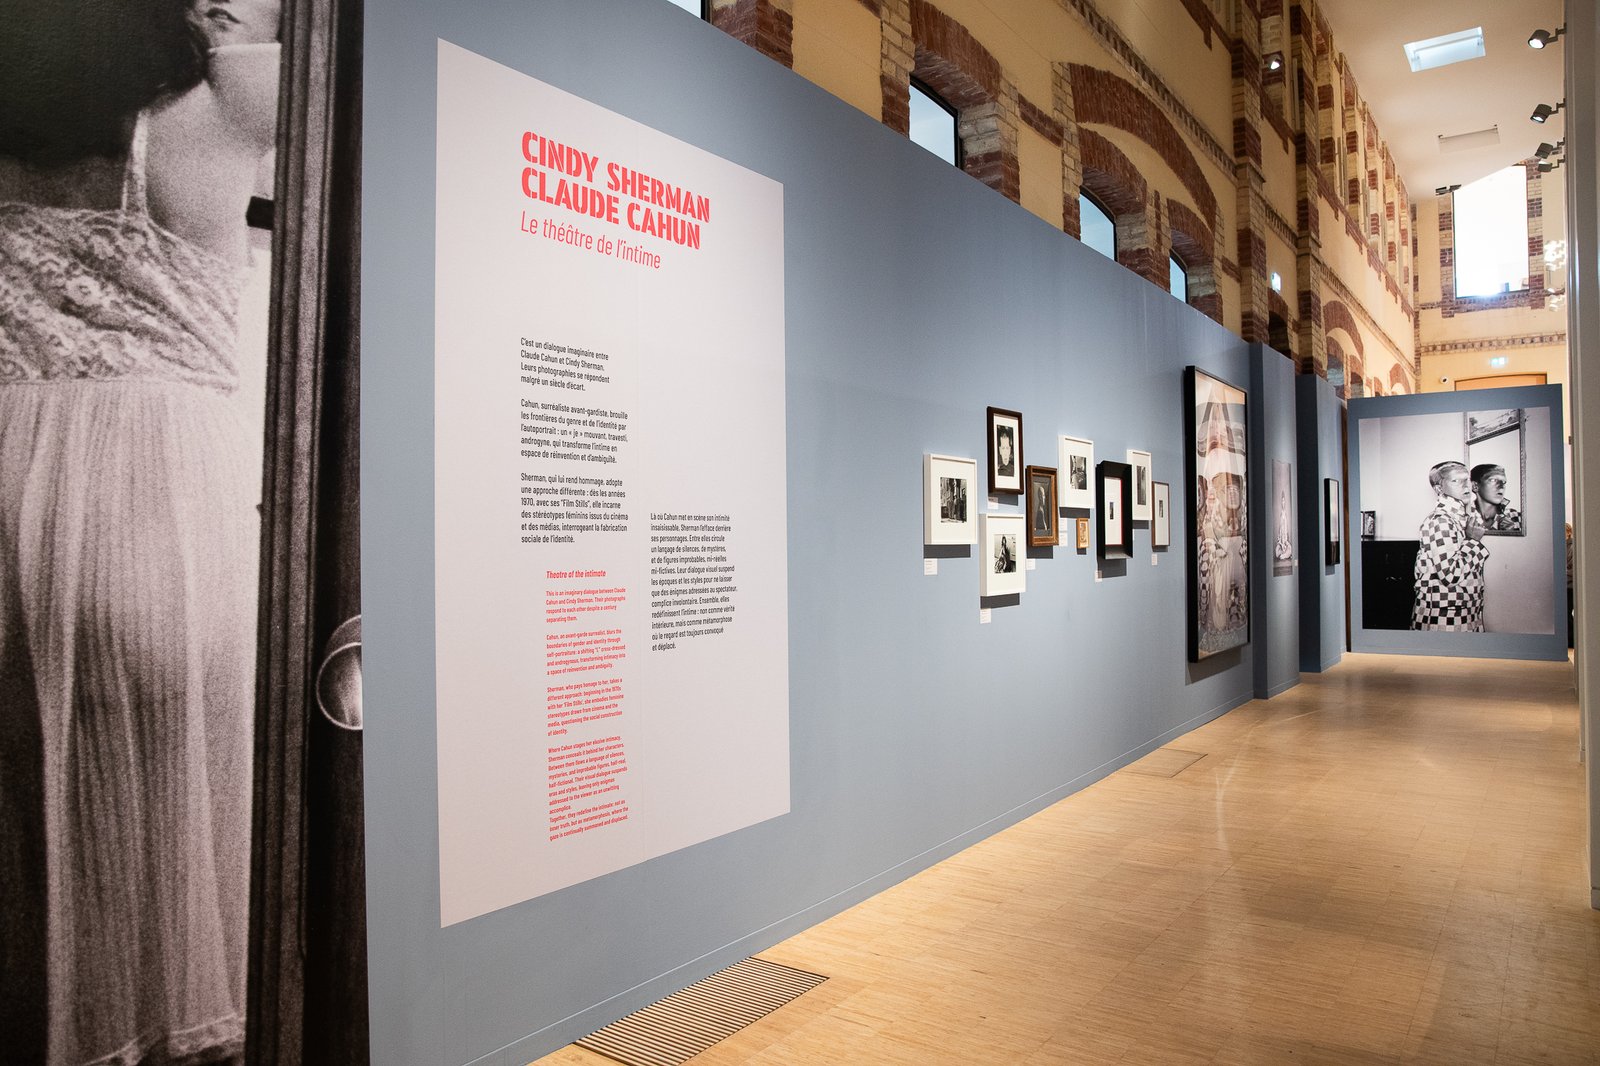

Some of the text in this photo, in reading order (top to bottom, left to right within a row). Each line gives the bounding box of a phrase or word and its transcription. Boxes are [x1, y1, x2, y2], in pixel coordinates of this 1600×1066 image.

[522, 132, 710, 223] CINDY SHERMAN
[522, 167, 700, 250] CLAUDE CAHUN
[521, 211, 660, 269] Le théâtre de l'intime
[521, 337, 534, 347] C'est
[543, 342, 566, 354] dialogue
[567, 345, 595, 358] imaginaire
[595, 353, 609, 361] entre
[521, 349, 540, 361] Claude
[541, 353, 558, 363] Cahun
[559, 357, 565, 365] et
[565, 357, 580, 369] Cindy
[521, 362, 537, 372] Leurs
[538, 365, 576, 379] photographies
[584, 373, 610, 383] répondent
[521, 375, 541, 386] malgré
[549, 378, 565, 389] siècle
[541, 403, 570, 413] surréaliste
[610, 410, 628, 420] brouille
[521, 411, 529, 420] les
[530, 412, 557, 423] frontières
[558, 416, 566, 424] du
[566, 418, 581, 426] genre
[588, 419, 595, 427] de
[573, 429, 579, 439] je
[552, 439, 561, 449] qui
[562, 440, 591, 450] transforme
[521, 450, 541, 459] espace
[542, 450, 549, 459] de
[550, 450, 580, 461] réinvention
[548, 474, 557, 485] qui
[565, 476, 578, 484] rend
[606, 478, 623, 488] adopte
[533, 487, 559, 495] approche
[559, 487, 586, 496] différente
[589, 489, 599, 497] dès
[599, 489, 607, 497] les
[608, 490, 626, 498] années
[592, 500, 601, 509] elle
[602, 500, 621, 509] incarne
[521, 510, 628, 520] des stéréotypes féminins issus du cinéma
[521, 523, 527, 531] et
[528, 522, 539, 531] des
[562, 523, 594, 532] interrogeant
[595, 523, 600, 531] la
[600, 523, 627, 532] fabrication
[521, 535, 541, 543] sociale
[542, 535, 550, 543] de
[547, 570, 606, 579] Theatre of the intimate
